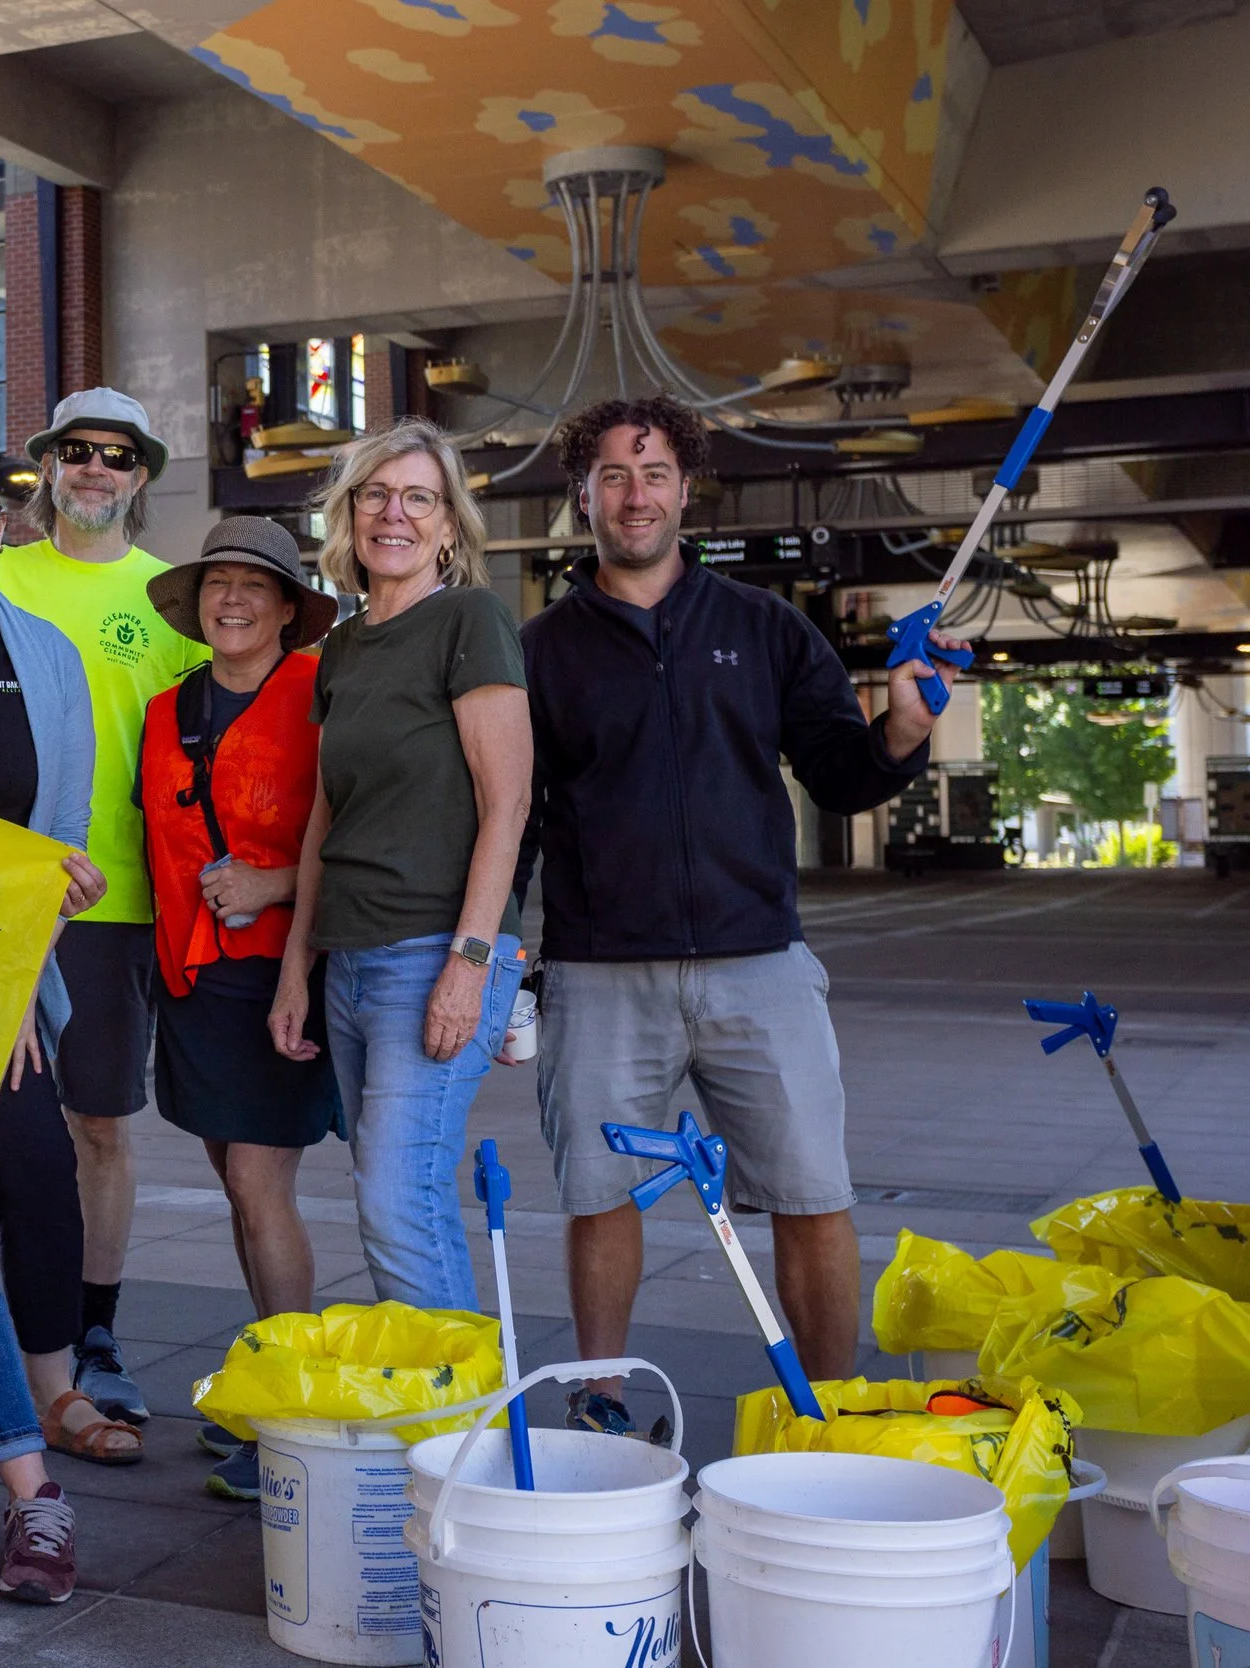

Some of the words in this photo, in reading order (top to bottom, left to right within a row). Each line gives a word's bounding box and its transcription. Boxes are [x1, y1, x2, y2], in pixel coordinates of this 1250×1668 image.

[102, 612, 142, 627] CLEANER
[139, 627, 150, 649] ALKI
[99, 640, 145, 659] COMMUNITY
[103, 647, 139, 664] CLEANUPS
